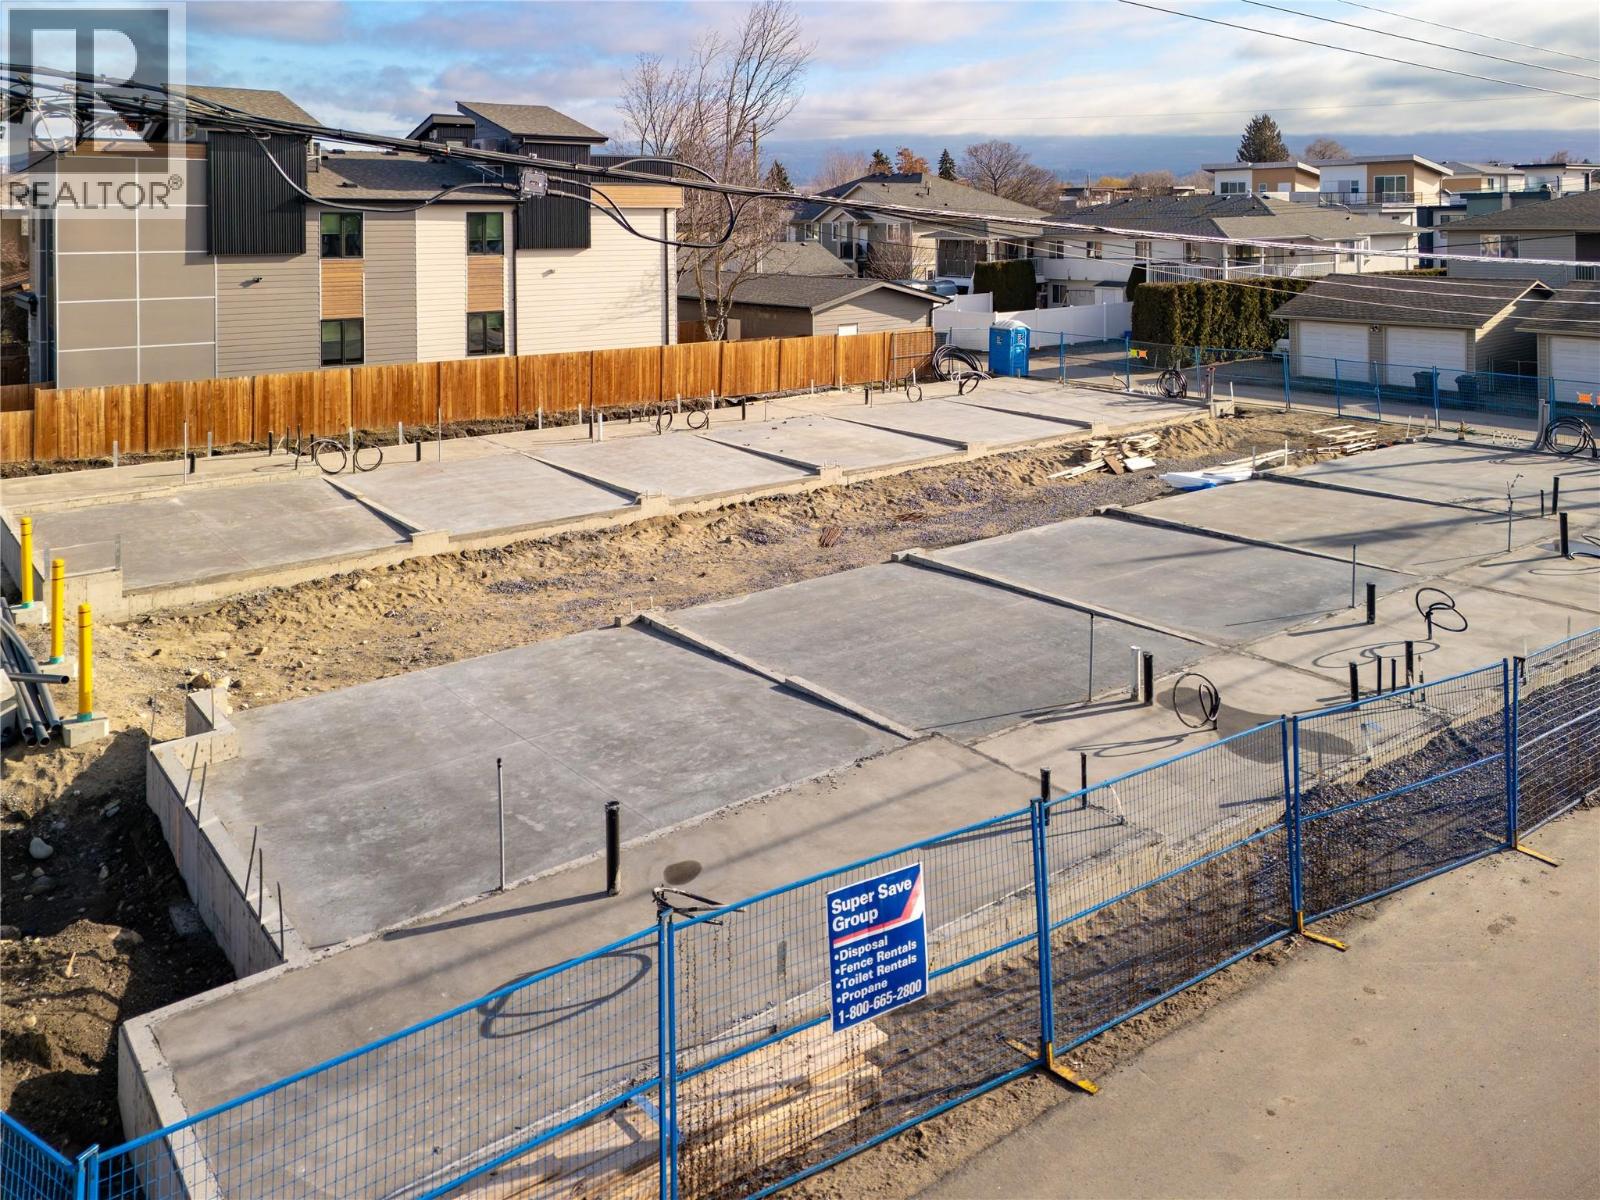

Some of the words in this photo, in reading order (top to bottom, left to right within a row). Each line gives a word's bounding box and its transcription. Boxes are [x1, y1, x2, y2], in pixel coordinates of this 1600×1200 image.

[831, 890, 875, 915] Super
[878, 878, 912, 899] Save
[832, 908, 879, 932] Group
[839, 936, 888, 962] Disposal
[840, 955, 873, 975] Fence
[877, 940, 917, 963] Rentals
[840, 969, 873, 990] Toilet
[877, 954, 917, 977] Rentals
[838, 979, 922, 1024] 1-800-665-2800
[841, 979, 888, 1004] Propane
